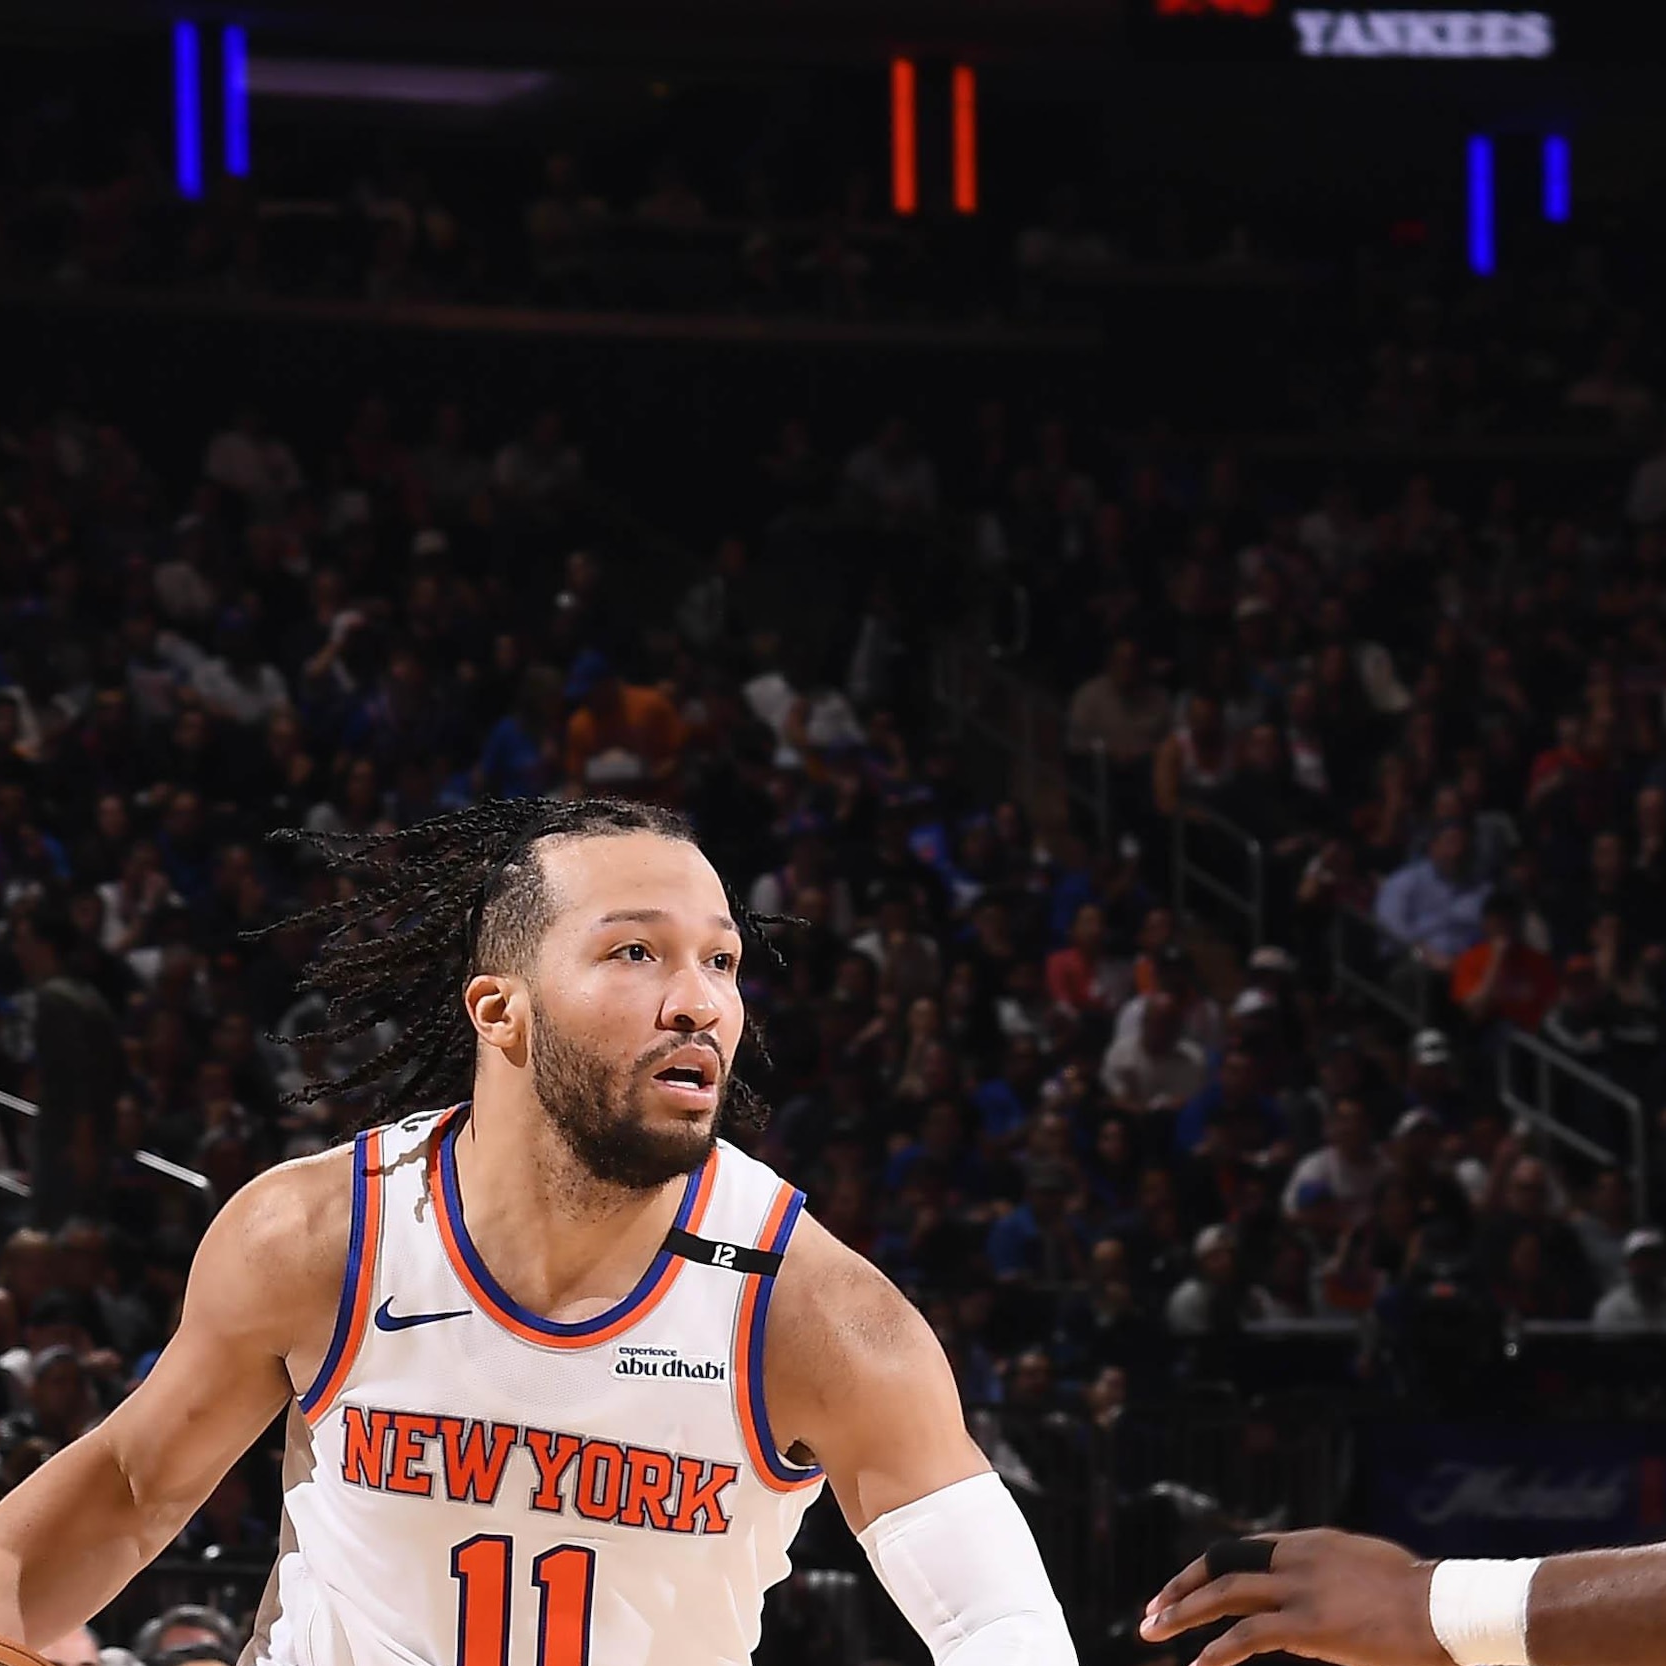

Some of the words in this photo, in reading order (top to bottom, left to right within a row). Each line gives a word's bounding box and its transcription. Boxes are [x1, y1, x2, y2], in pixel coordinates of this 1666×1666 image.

[1293, 9, 1555, 58] YANKEES
[711, 1243, 737, 1268] 12
[619, 1346, 677, 1357] experience
[615, 1356, 658, 1377] abu
[662, 1358, 726, 1381] dhabi
[342, 1405, 517, 1504] NEW
[524, 1426, 739, 1535] YORK
